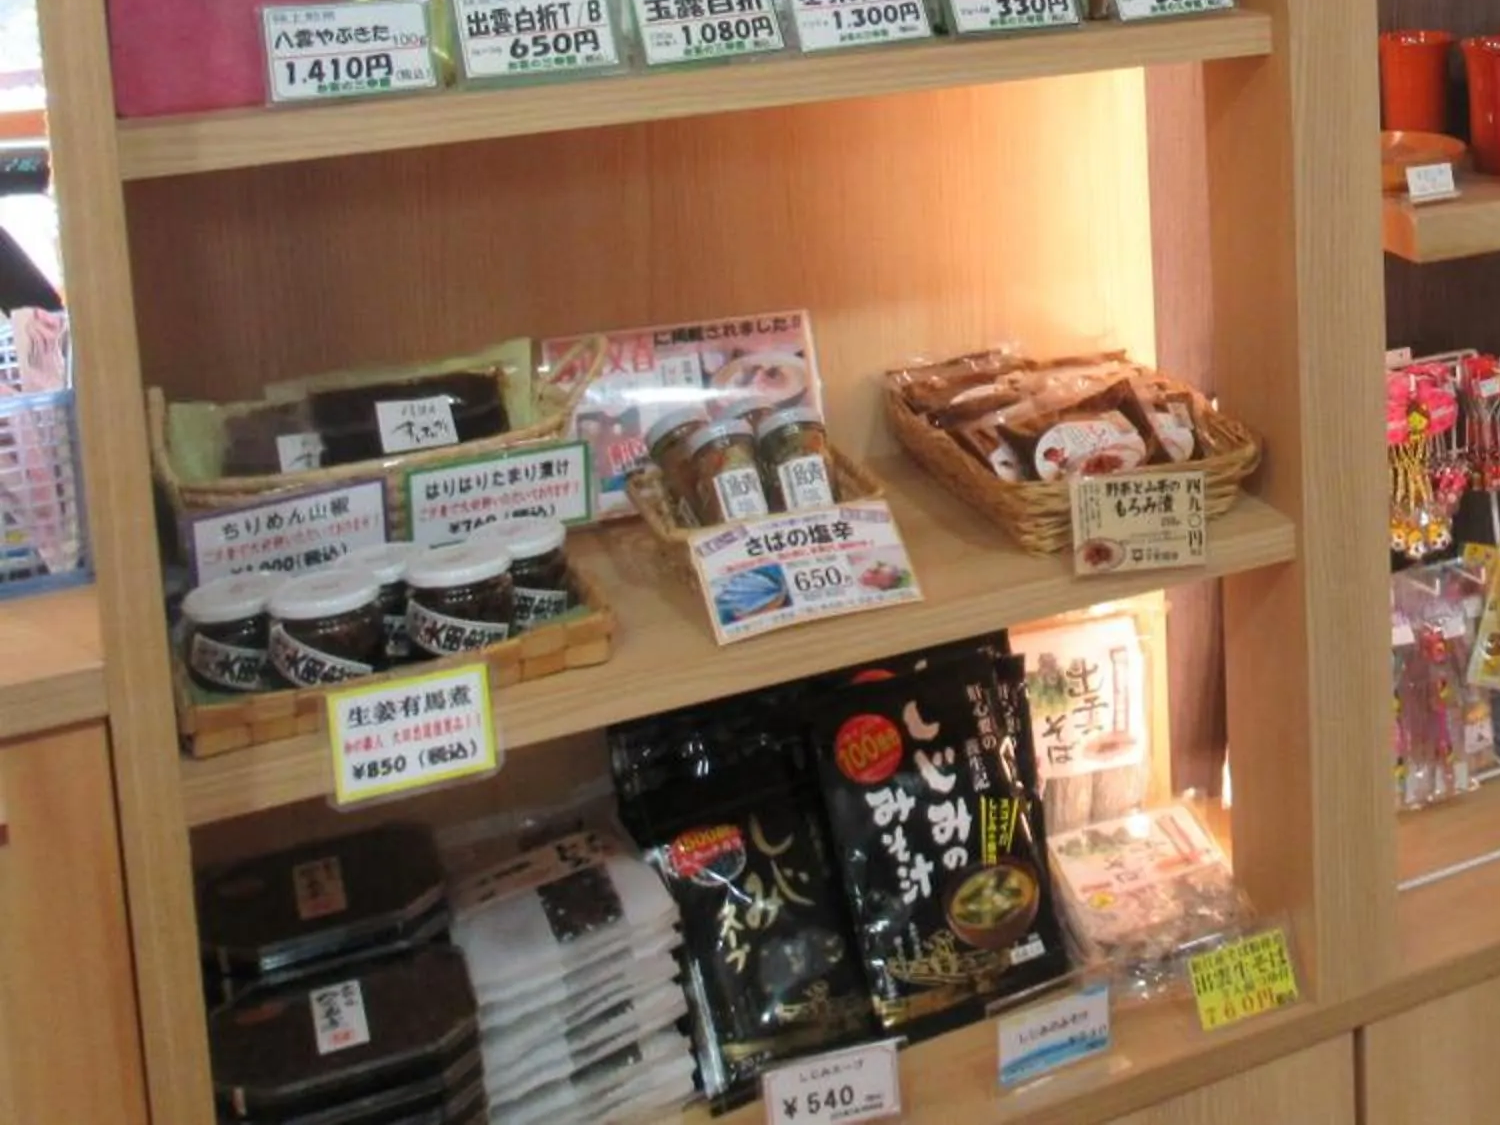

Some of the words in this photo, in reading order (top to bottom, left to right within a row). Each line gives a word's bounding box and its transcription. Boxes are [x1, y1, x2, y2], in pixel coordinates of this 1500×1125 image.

[273, 25, 391, 50] 八雲やぶきた
[509, 29, 600, 59] 650円
[425, 458, 571, 500] はりはりたまり漬け
[221, 495, 351, 541] ちりめん山椒
[745, 520, 854, 557] さばの塩辛
[347, 684, 473, 730] 生姜有馬煮
[352, 755, 407, 780] ¥850
